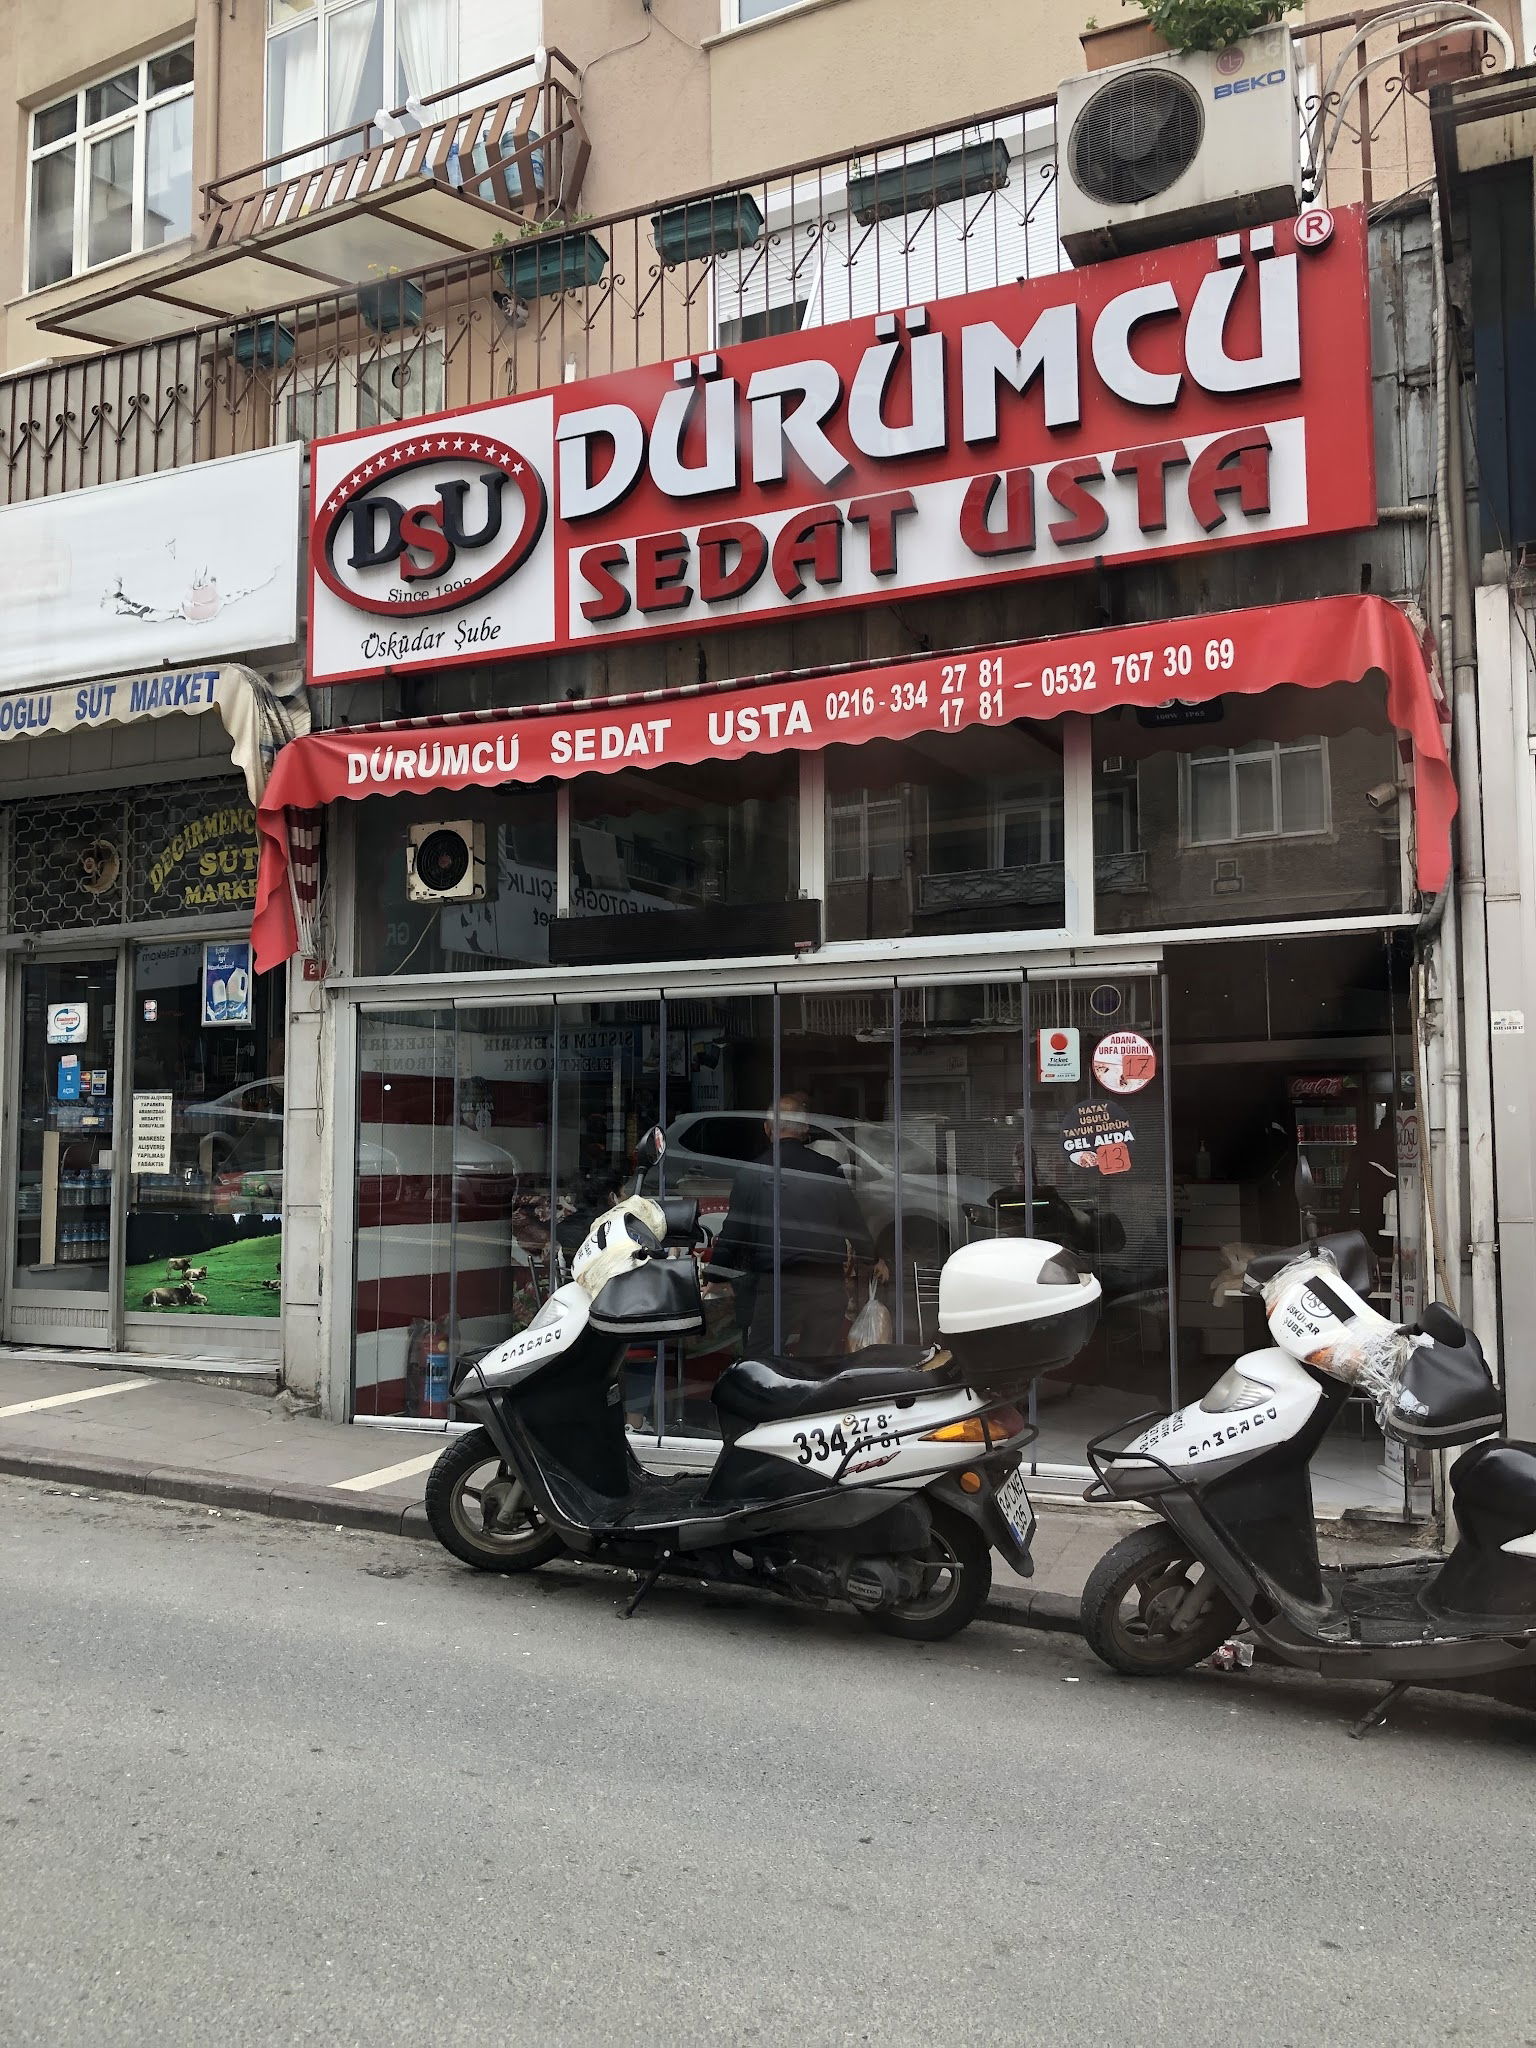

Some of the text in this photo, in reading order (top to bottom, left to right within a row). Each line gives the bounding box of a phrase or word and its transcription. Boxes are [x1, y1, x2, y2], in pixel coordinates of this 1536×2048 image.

[1214, 69, 1286, 100] BEKO
[553, 225, 1303, 521] DÜRÜMCÜ
[347, 471, 509, 583] DSU
[579, 425, 1272, 622] SEDAT USTA
[388, 588, 430, 602] Since
[361, 616, 501, 660] Üsküdar Şube
[75, 684, 117, 721] SÜT
[130, 671, 220, 713] MARKET
[347, 732, 520, 785] DÜRÜMCÜ
[550, 718, 672, 765] SEDAT
[707, 699, 813, 747] USTA
[941, 664, 966, 696] 27
[978, 657, 1003, 687] 81
[1041, 661, 1097, 697] 0532
[1112, 651, 1154, 687] 767
[1163, 644, 1192, 677] 30
[1205, 638, 1235, 671] 69
[939, 688, 1004, 728] 17 81
[199, 846, 259, 877] SÜT
[1099, 1044, 1149, 1054] URFA DÜRÜM
[1110, 1036, 1137, 1044] ADANA
[1127, 1058, 1150, 1077] 17
[1078, 1104, 1108, 1115] HATAY
[1080, 1112, 1110, 1124] USULÜ
[1063, 1120, 1130, 1137] TAVUK DÜRÜM
[1064, 1130, 1135, 1151] GEL AL'DA
[1102, 1148, 1125, 1170] 13
[793, 1423, 848, 1465] 334
[851, 1418, 870, 1435] 27
